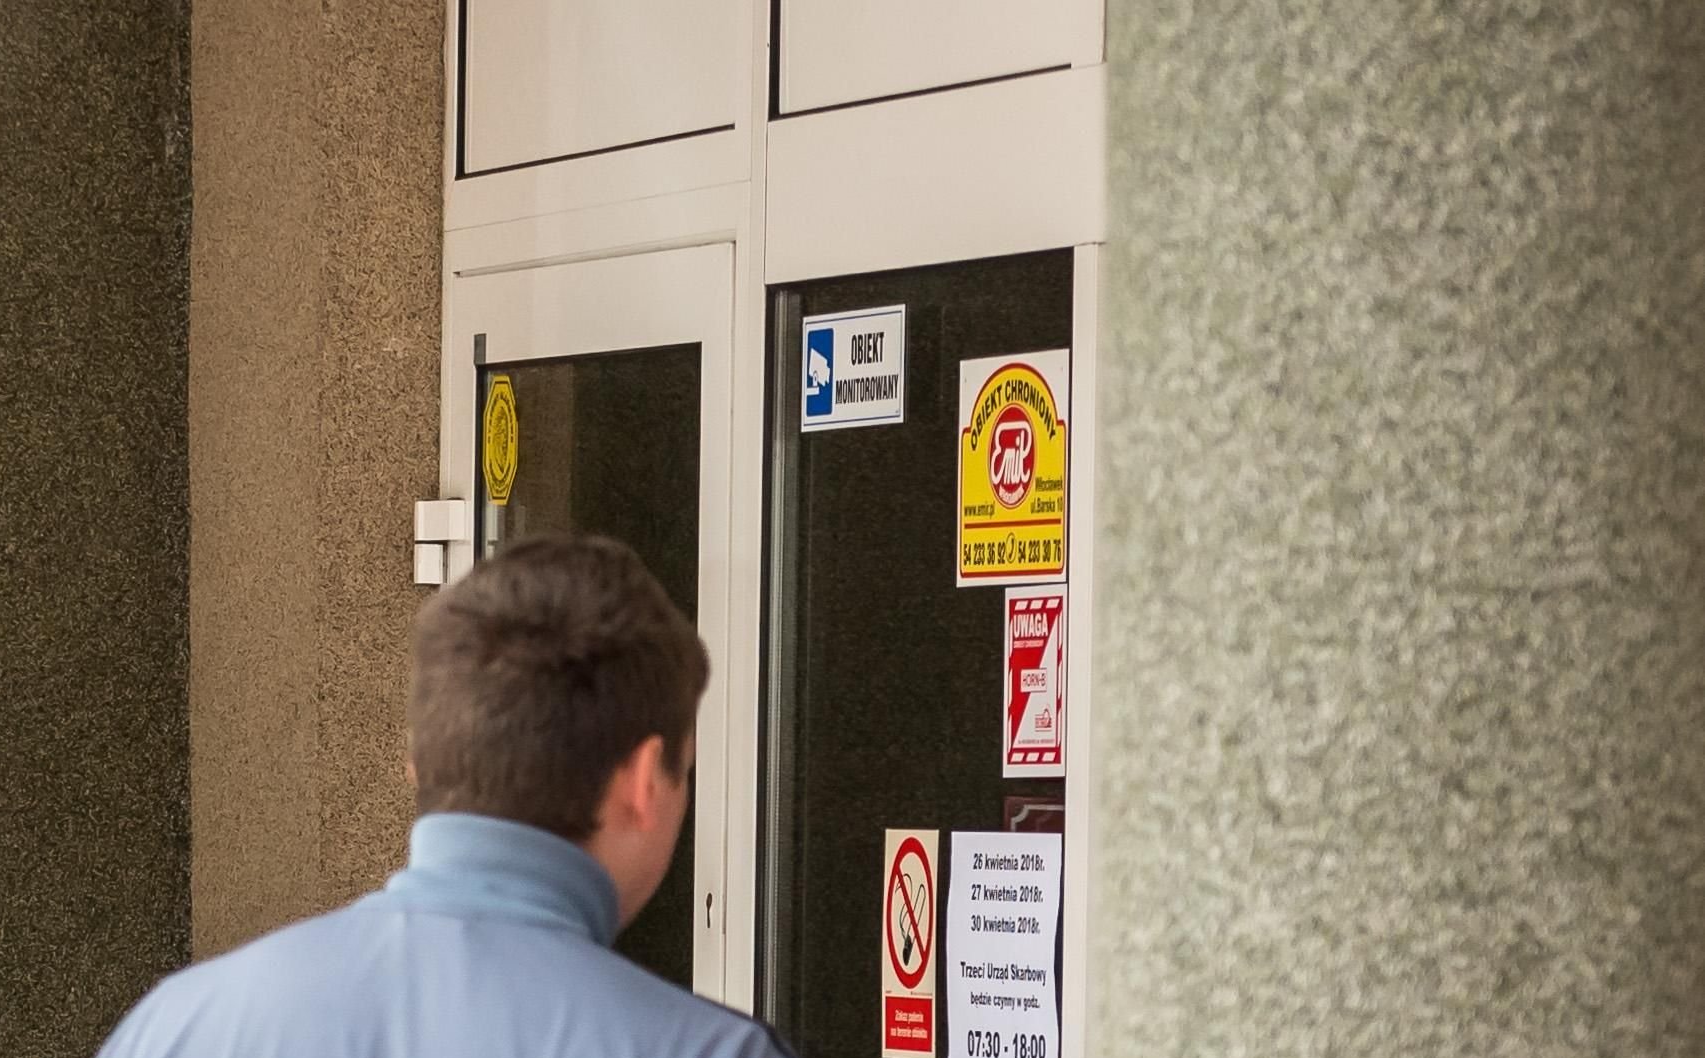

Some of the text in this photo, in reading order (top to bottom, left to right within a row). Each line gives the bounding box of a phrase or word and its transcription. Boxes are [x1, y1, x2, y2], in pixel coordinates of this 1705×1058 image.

[851, 332, 884, 366] OBIEKT
[835, 374, 899, 405] MONITOROWANY
[971, 379, 1056, 451] OBIEKT CHRONIONY
[963, 543, 972, 566] 54
[998, 541, 1006, 564] 92
[1018, 541, 1026, 564] 54
[1013, 612, 1049, 638] UWAGA
[973, 853, 1045, 871] 26 kwietnia 2018r.
[971, 884, 1044, 902] 27 kwietnia 2018r.
[971, 915, 1040, 934] 30 kwietnia 2018r.
[960, 961, 1046, 986] Trzeci Urząd Skarbowy
[970, 992, 991, 1008] będzie
[993, 996, 1015, 1010] czynny
[1023, 994, 1040, 1012] godz.
[968, 1030, 1000, 1058] 07:30
